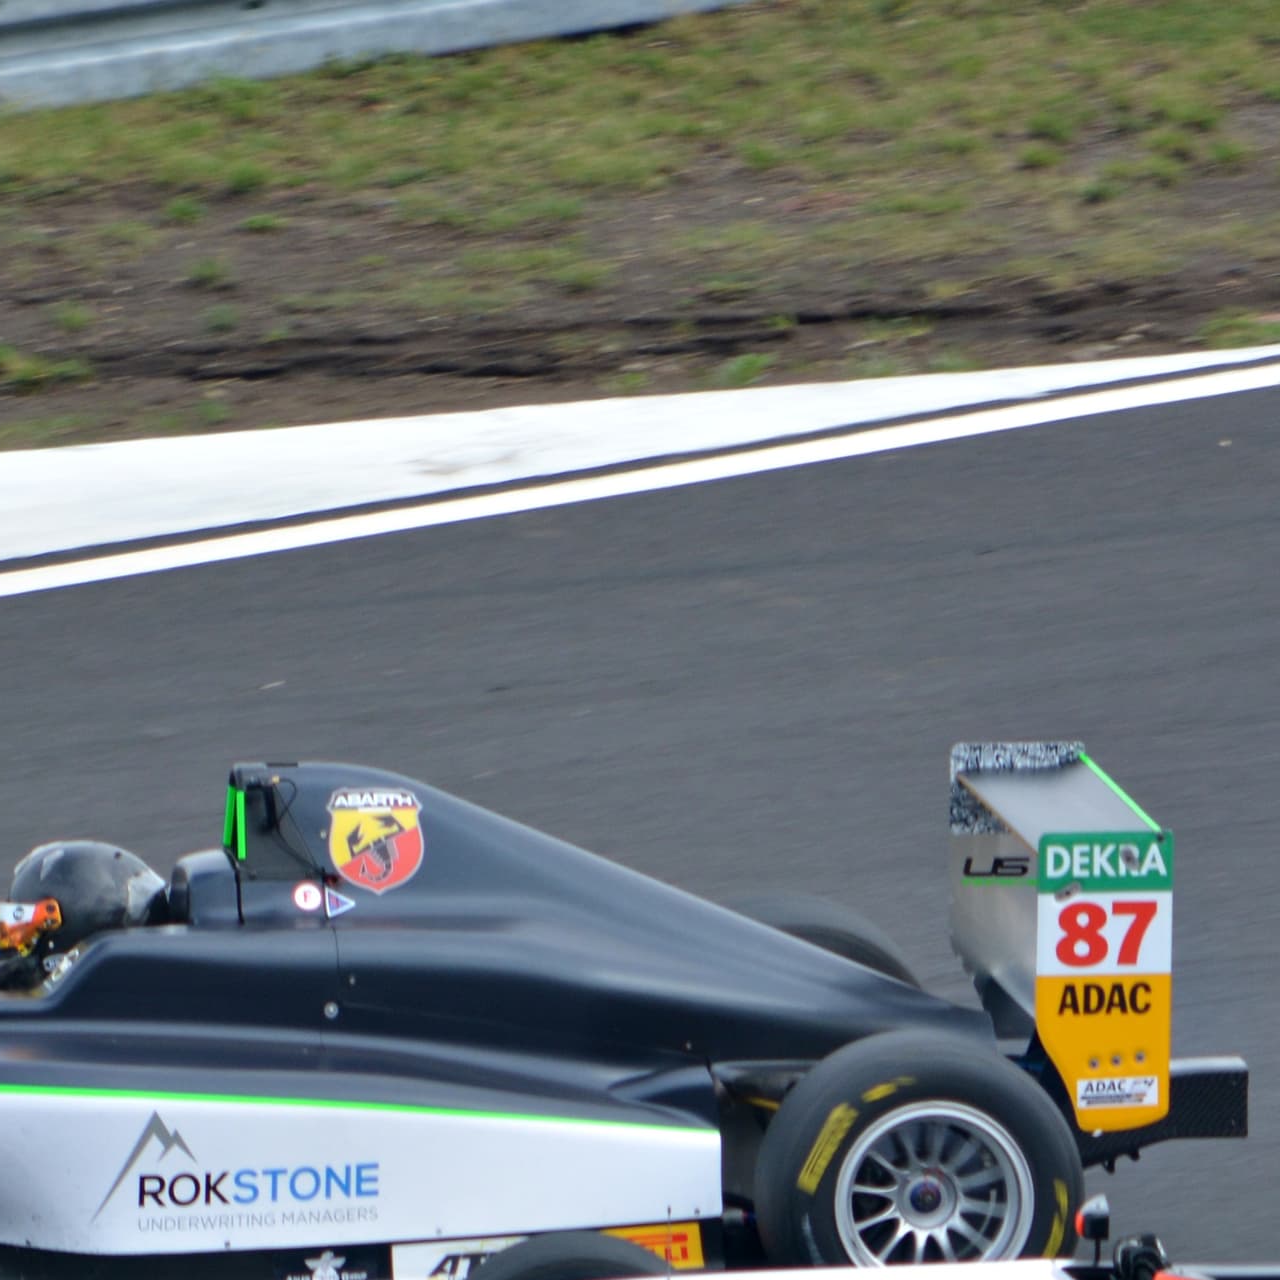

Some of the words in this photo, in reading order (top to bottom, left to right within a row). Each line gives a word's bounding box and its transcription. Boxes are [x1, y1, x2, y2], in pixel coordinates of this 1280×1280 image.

[335, 792, 413, 808] ABARTH
[1046, 842, 1168, 878] DEKRA
[1055, 901, 1158, 967] 87
[1058, 983, 1152, 1016] ADAC
[1084, 1080, 1125, 1093] ADAC
[138, 1162, 380, 1208] ROKSTONE
[138, 1211, 275, 1233] UNDERWRITING
[282, 1206, 379, 1226] MANAGERS
